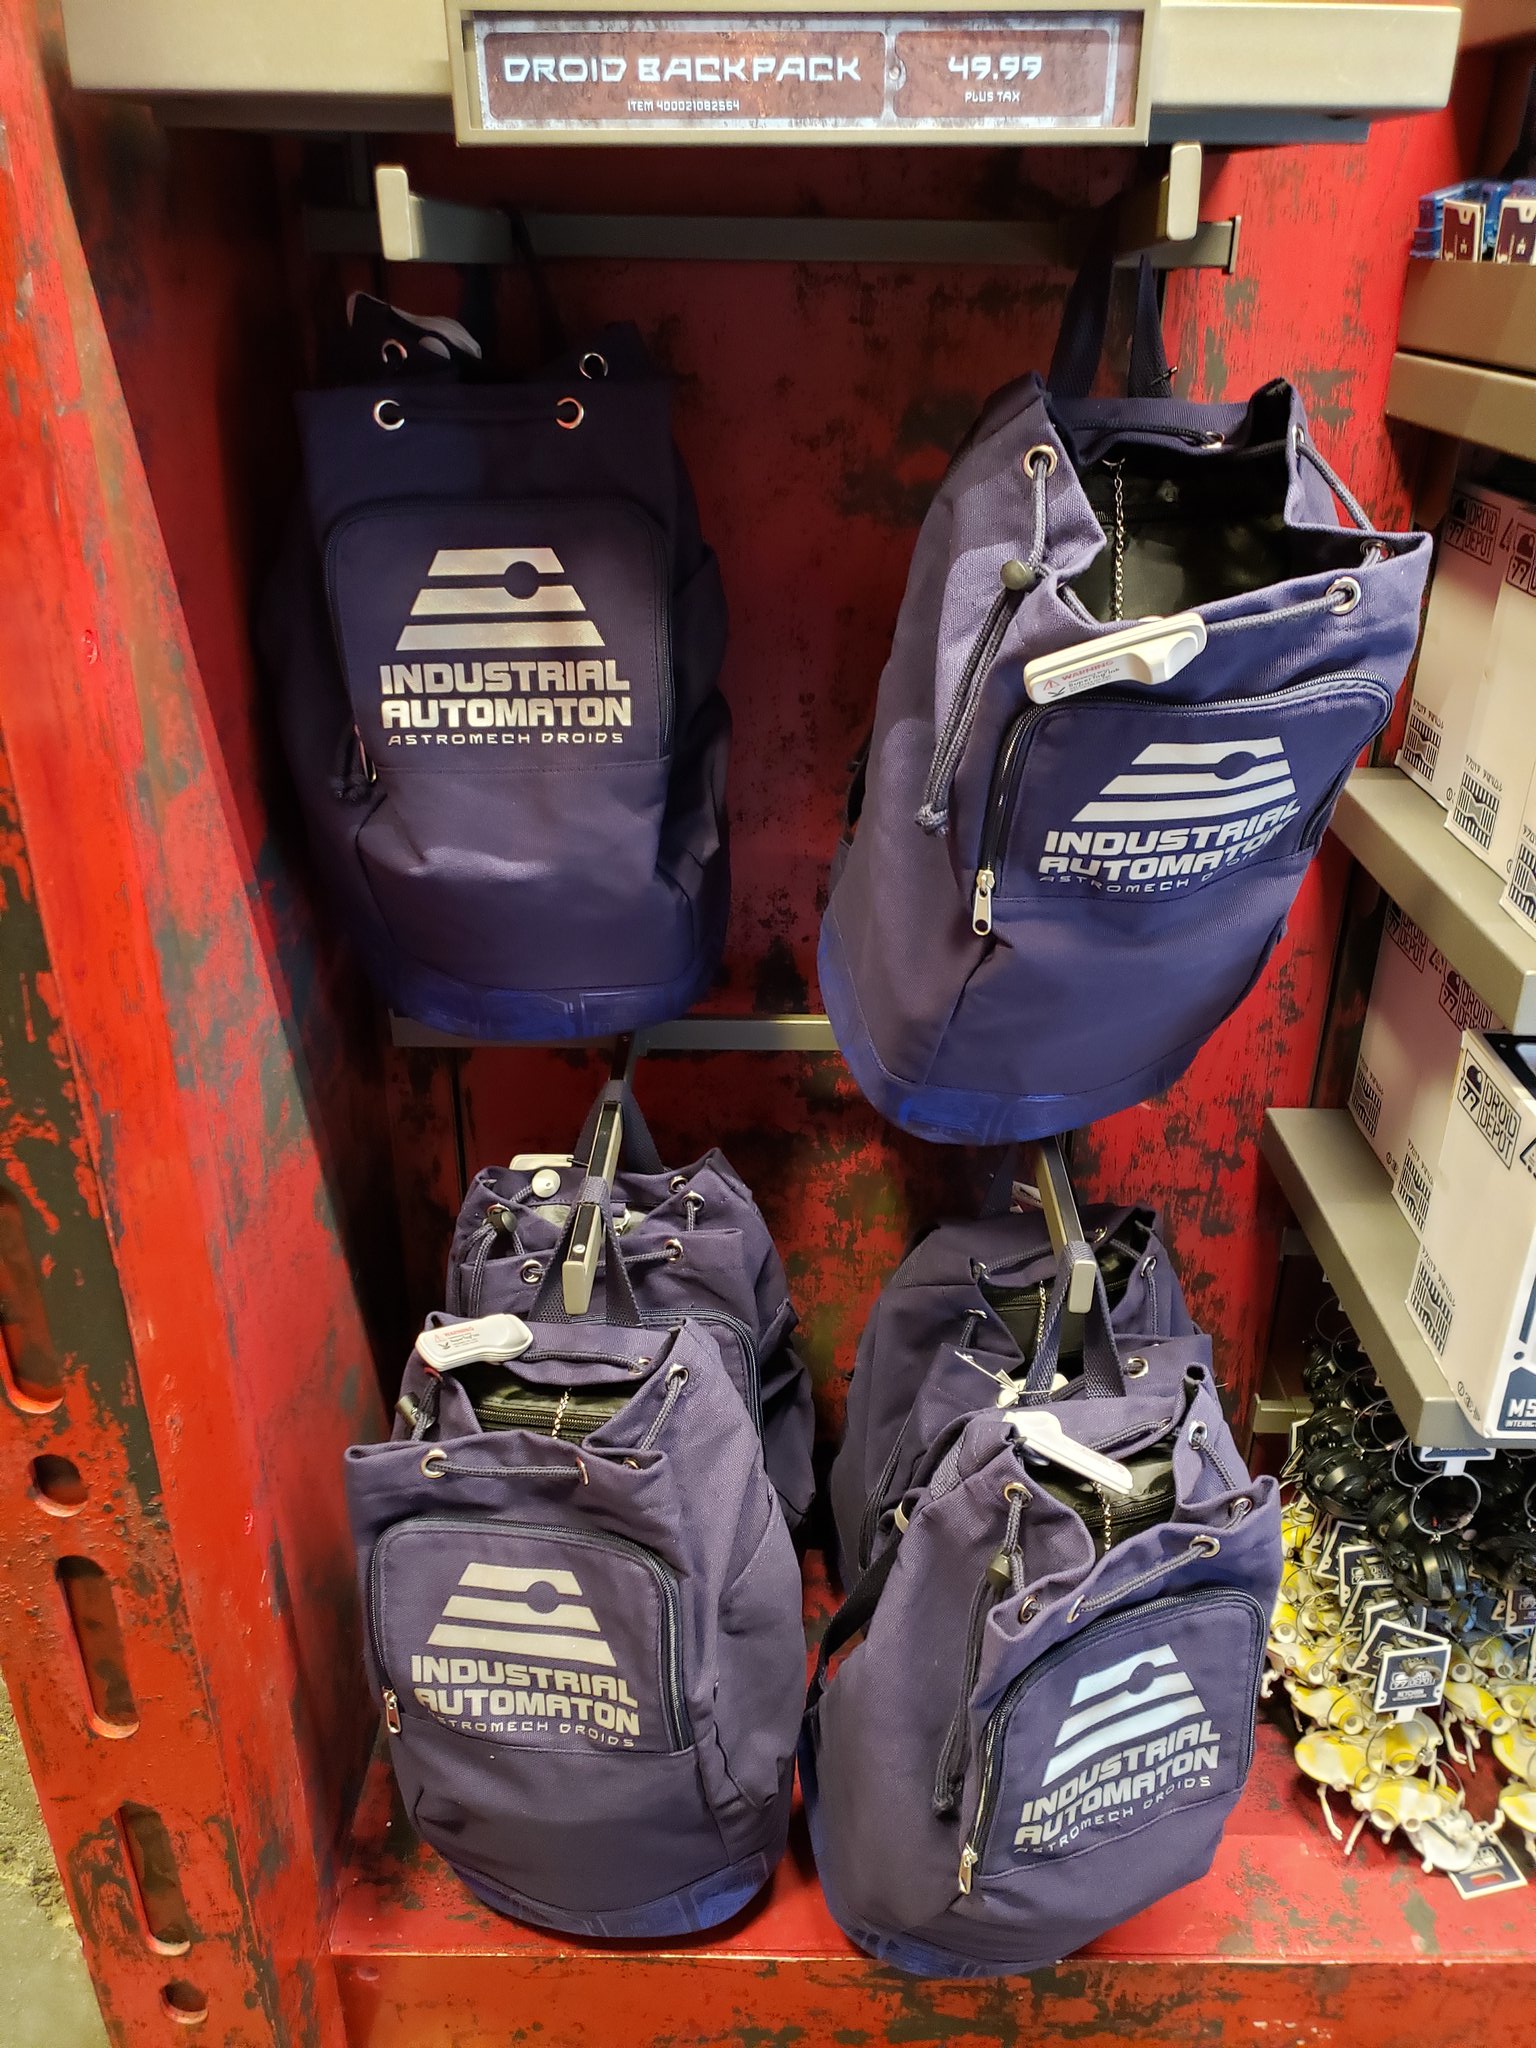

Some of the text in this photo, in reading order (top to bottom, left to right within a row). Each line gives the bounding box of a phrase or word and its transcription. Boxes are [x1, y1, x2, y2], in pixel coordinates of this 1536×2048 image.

[503, 56, 861, 82] DROID BACKPACK
[948, 55, 1042, 81] 49.99
[627, 100, 654, 112] ITEM
[965, 91, 1020, 102] PLUS TAX
[380, 660, 630, 694] INDUSTRIAL
[381, 697, 632, 728] AUTOMATON
[388, 733, 623, 745] ASTROMECH DROIDS
[1044, 799, 1301, 856] INDUSTRIAL
[1039, 817, 1294, 881] AUTOMATON
[1479, 1104, 1513, 1160] DEPOT
[411, 1655, 638, 1708] INDUSTRIAL
[414, 1688, 640, 1735] AUTOMATON
[428, 1711, 634, 1747] STROMECH DROIDS
[1020, 1720, 1220, 1823] INDUSTRIAL
[1014, 1745, 1219, 1845] AUTOMATON
[1143, 1776, 1211, 1809] DROIDS
